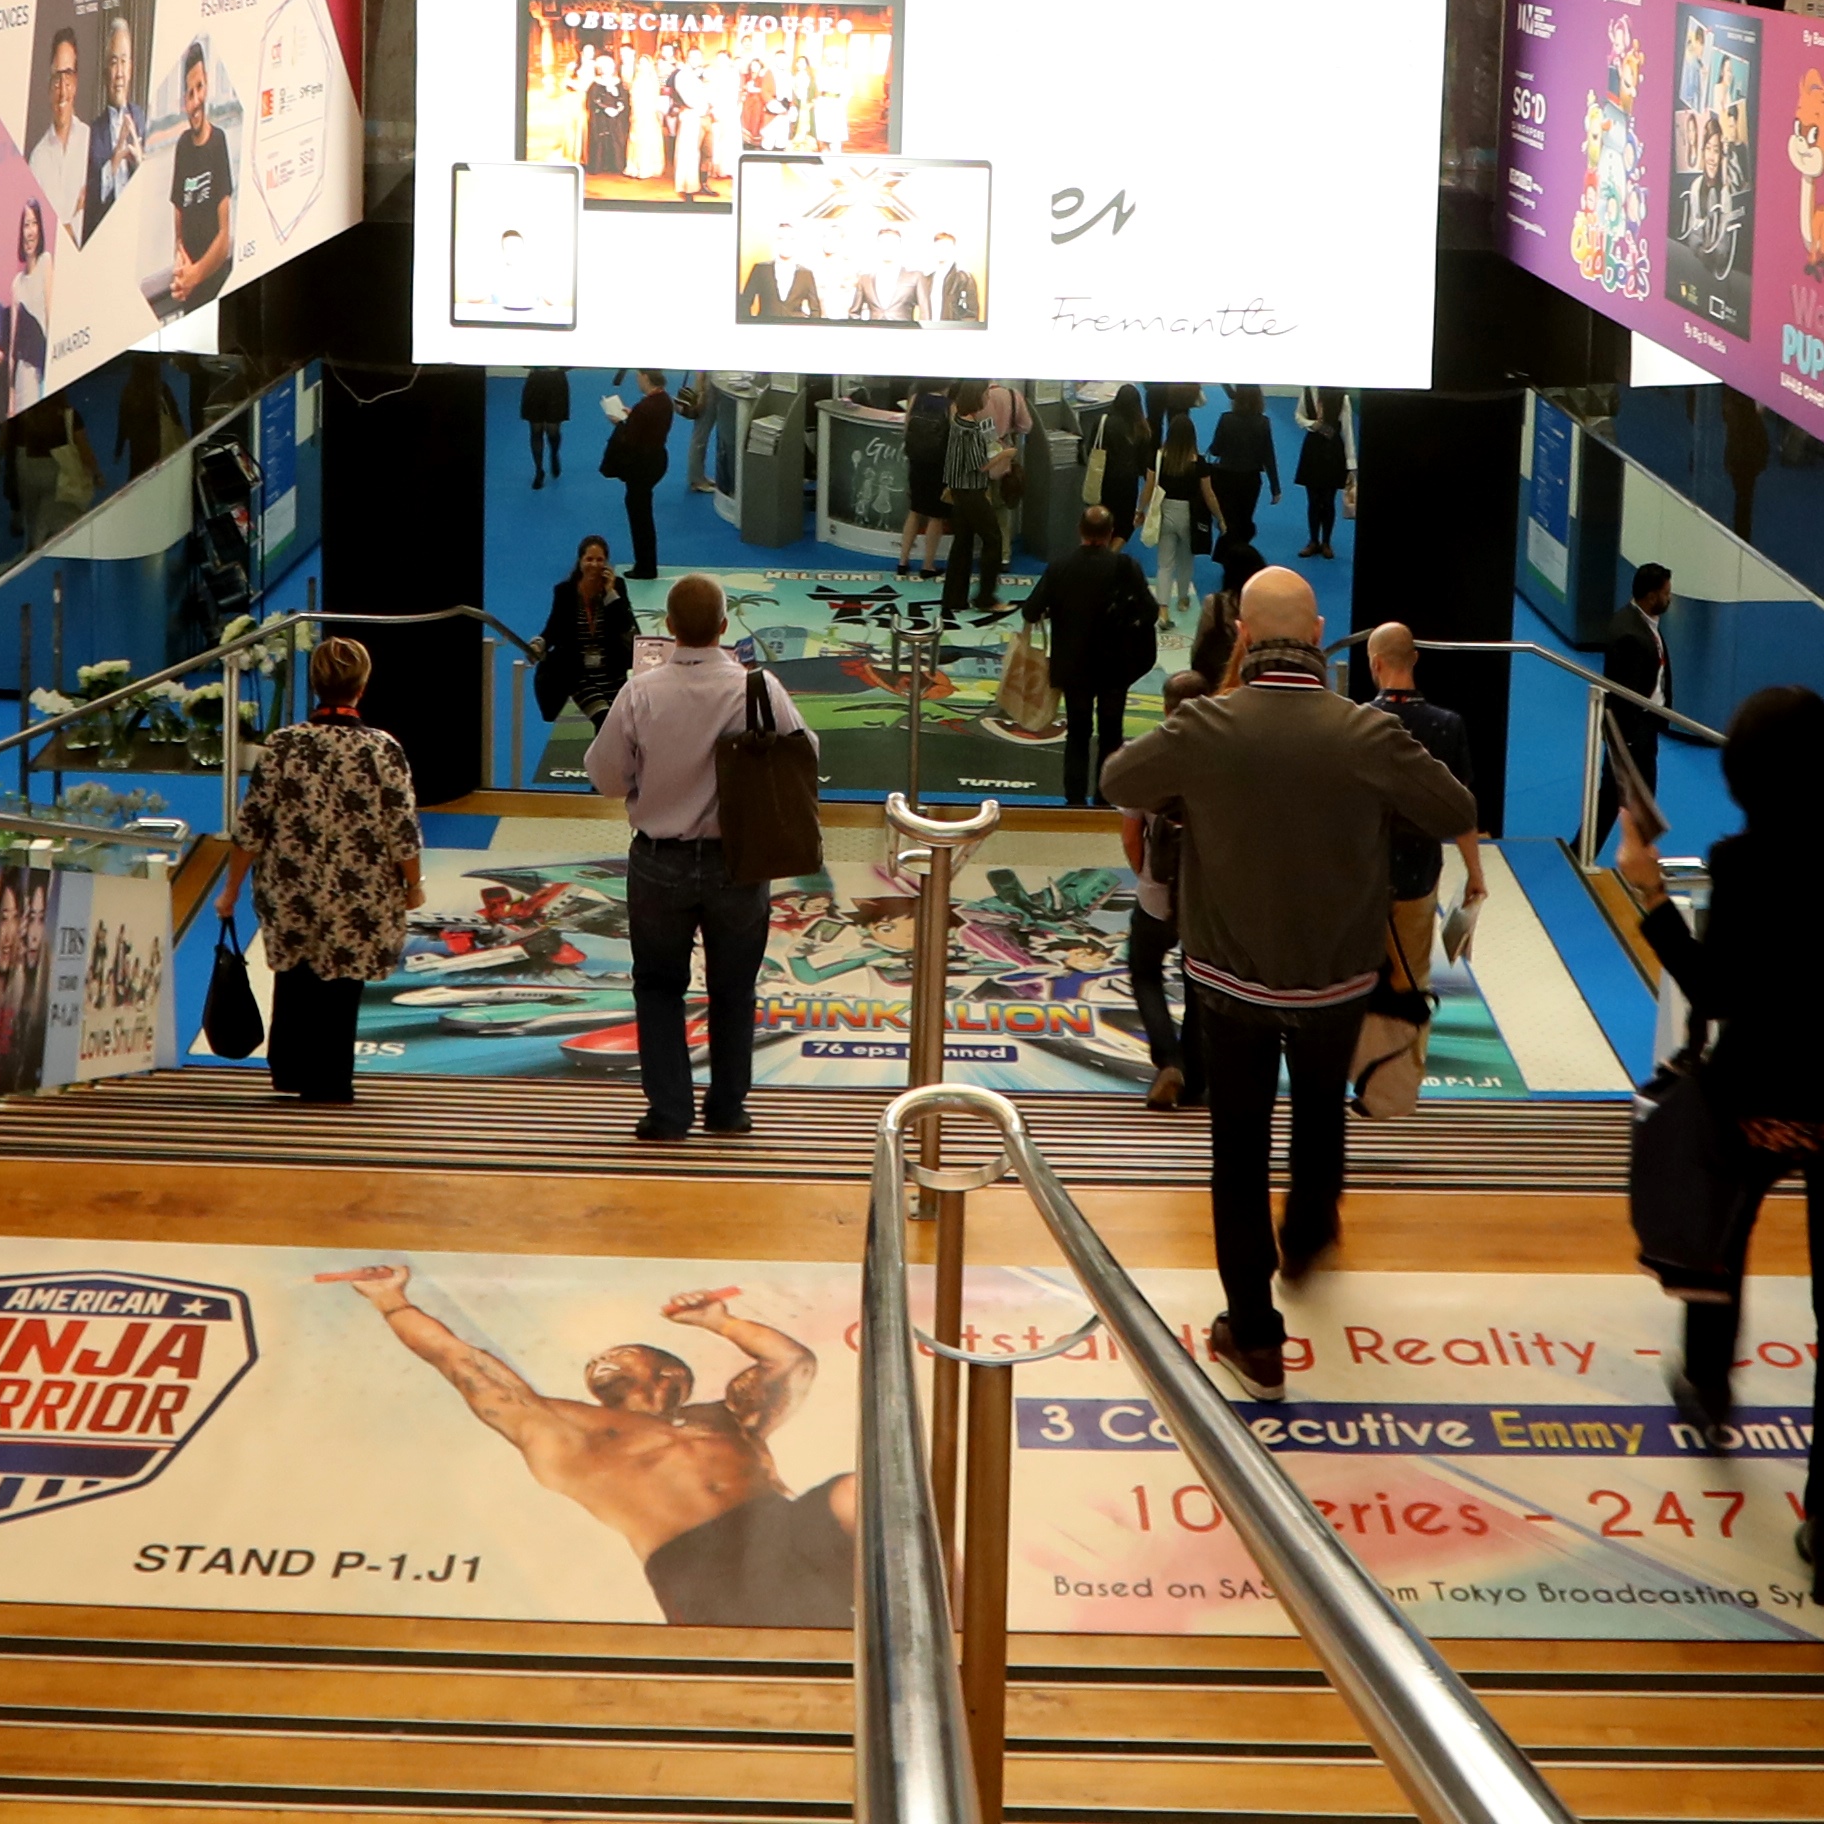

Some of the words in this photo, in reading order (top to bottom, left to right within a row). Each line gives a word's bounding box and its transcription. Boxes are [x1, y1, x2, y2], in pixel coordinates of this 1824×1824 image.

[581, 10, 725, 33] BEECHAM
[736, 14, 834, 35] HOUSE
[1803, 30, 1812, 47] By
[238, 240, 256, 263] LABS
[1051, 296, 1298, 337] Fremantle
[52, 326, 91, 363] AWARDS
[958, 778, 1037, 790] Turner
[58, 927, 85, 955] TBS
[811, 1042, 844, 1056] 76
[852, 1044, 898, 1062] eps
[2, 1286, 169, 1316] AMERICAN
[1353, 1326, 1596, 1374] Reality
[1040, 1406, 1074, 1443] 3
[1490, 1410, 1644, 1455] Emmy
[1312, 1491, 1491, 1537] eries
[1587, 1489, 1748, 1539] 247
[133, 1543, 315, 1574] STAND
[331, 1550, 483, 1584] P-1.J1
[1053, 1575, 1155, 1600] Based
[1168, 1584, 1207, 1600] on
[1428, 1580, 1530, 1608] Tokyo
[1538, 1583, 1760, 1610] Broadcasting
